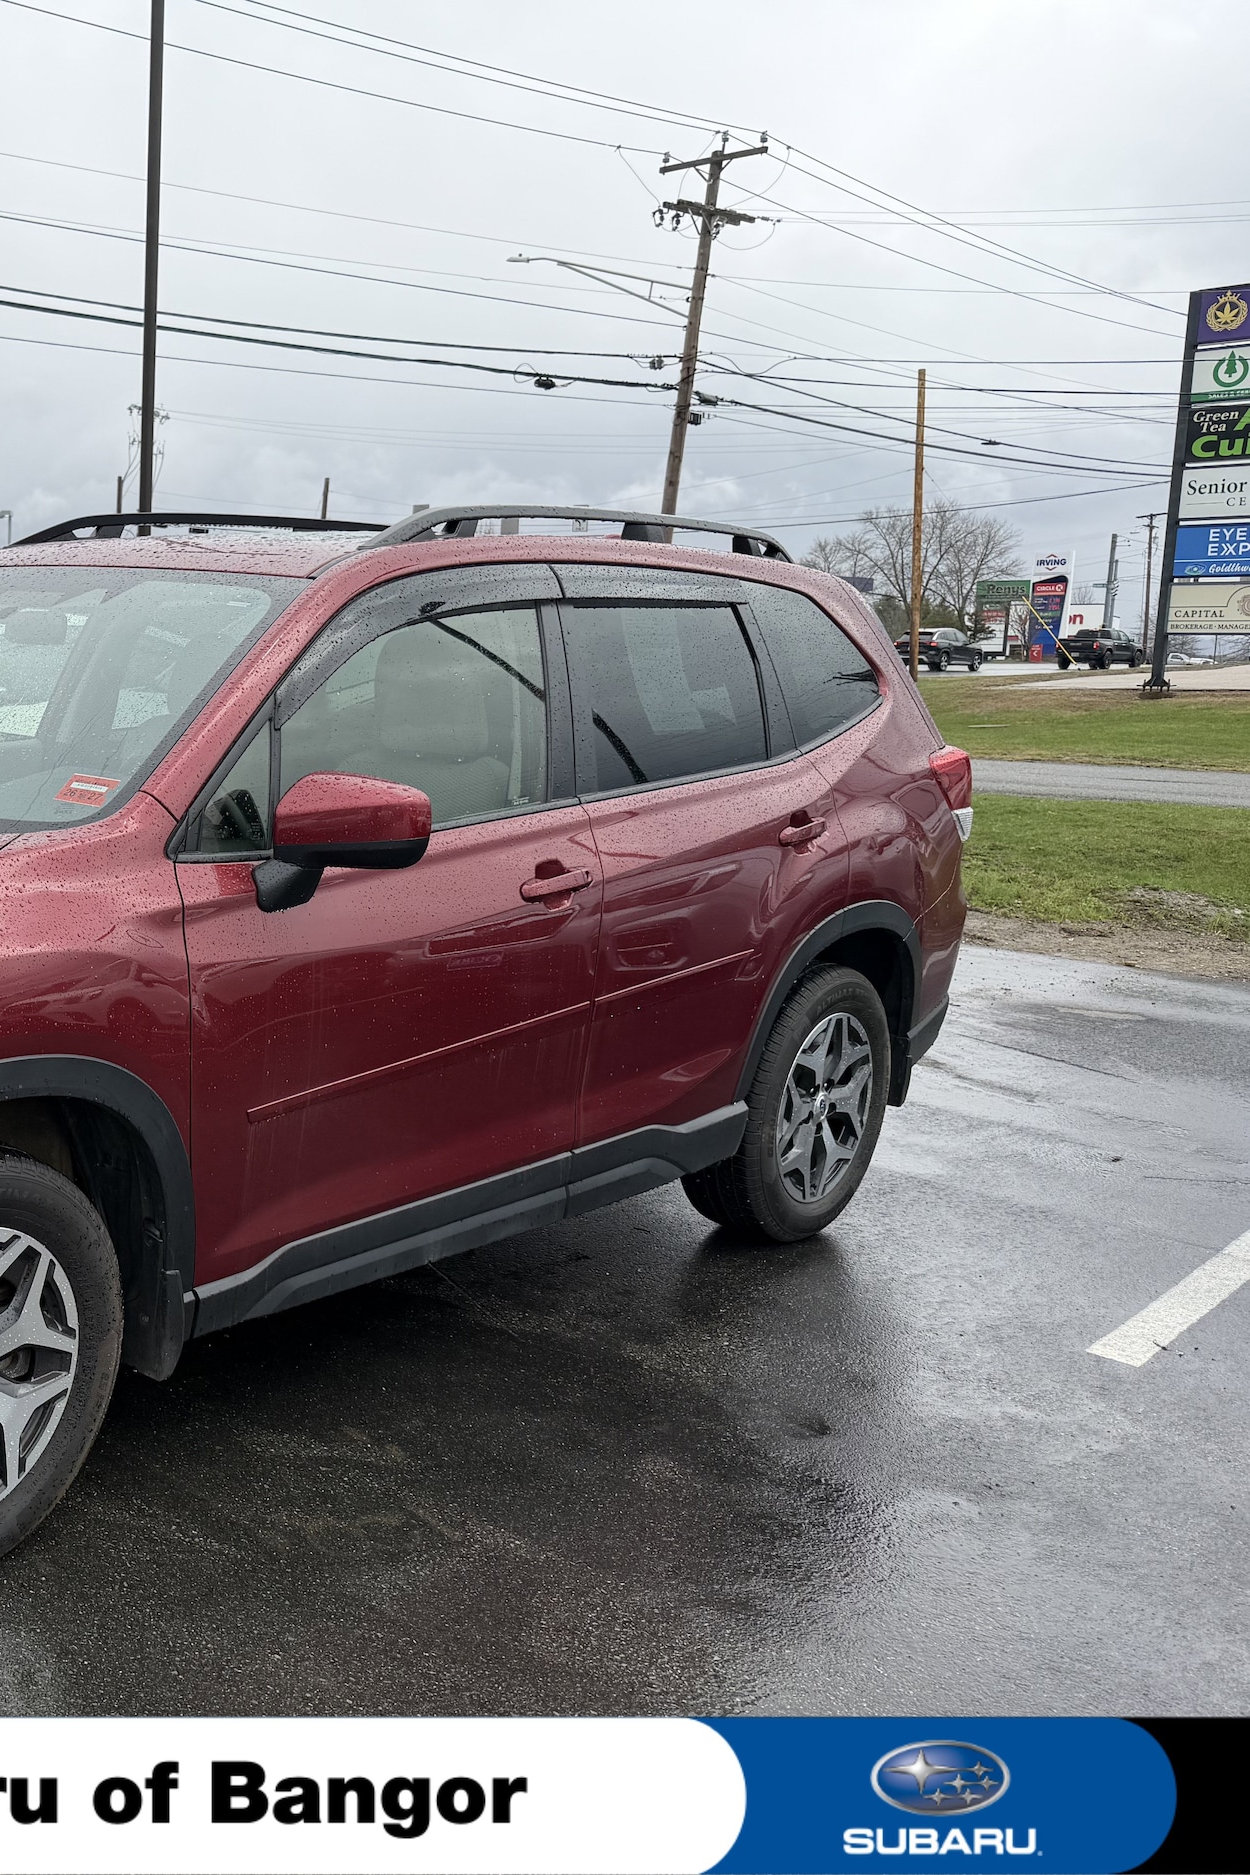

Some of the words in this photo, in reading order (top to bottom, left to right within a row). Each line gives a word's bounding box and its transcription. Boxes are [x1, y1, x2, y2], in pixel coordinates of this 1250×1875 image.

[1193, 411, 1239, 423] Green
[1200, 422, 1227, 433] Tea
[1187, 478, 1248, 496] Senior
[1209, 527, 1248, 541] EYE
[1036, 558, 1067, 567] IRVING
[986, 583, 1026, 597] Renys
[1174, 610, 1225, 618] CAPITAL
[63, 788, 78, 798] 26
[87, 792, 104, 802] 27
